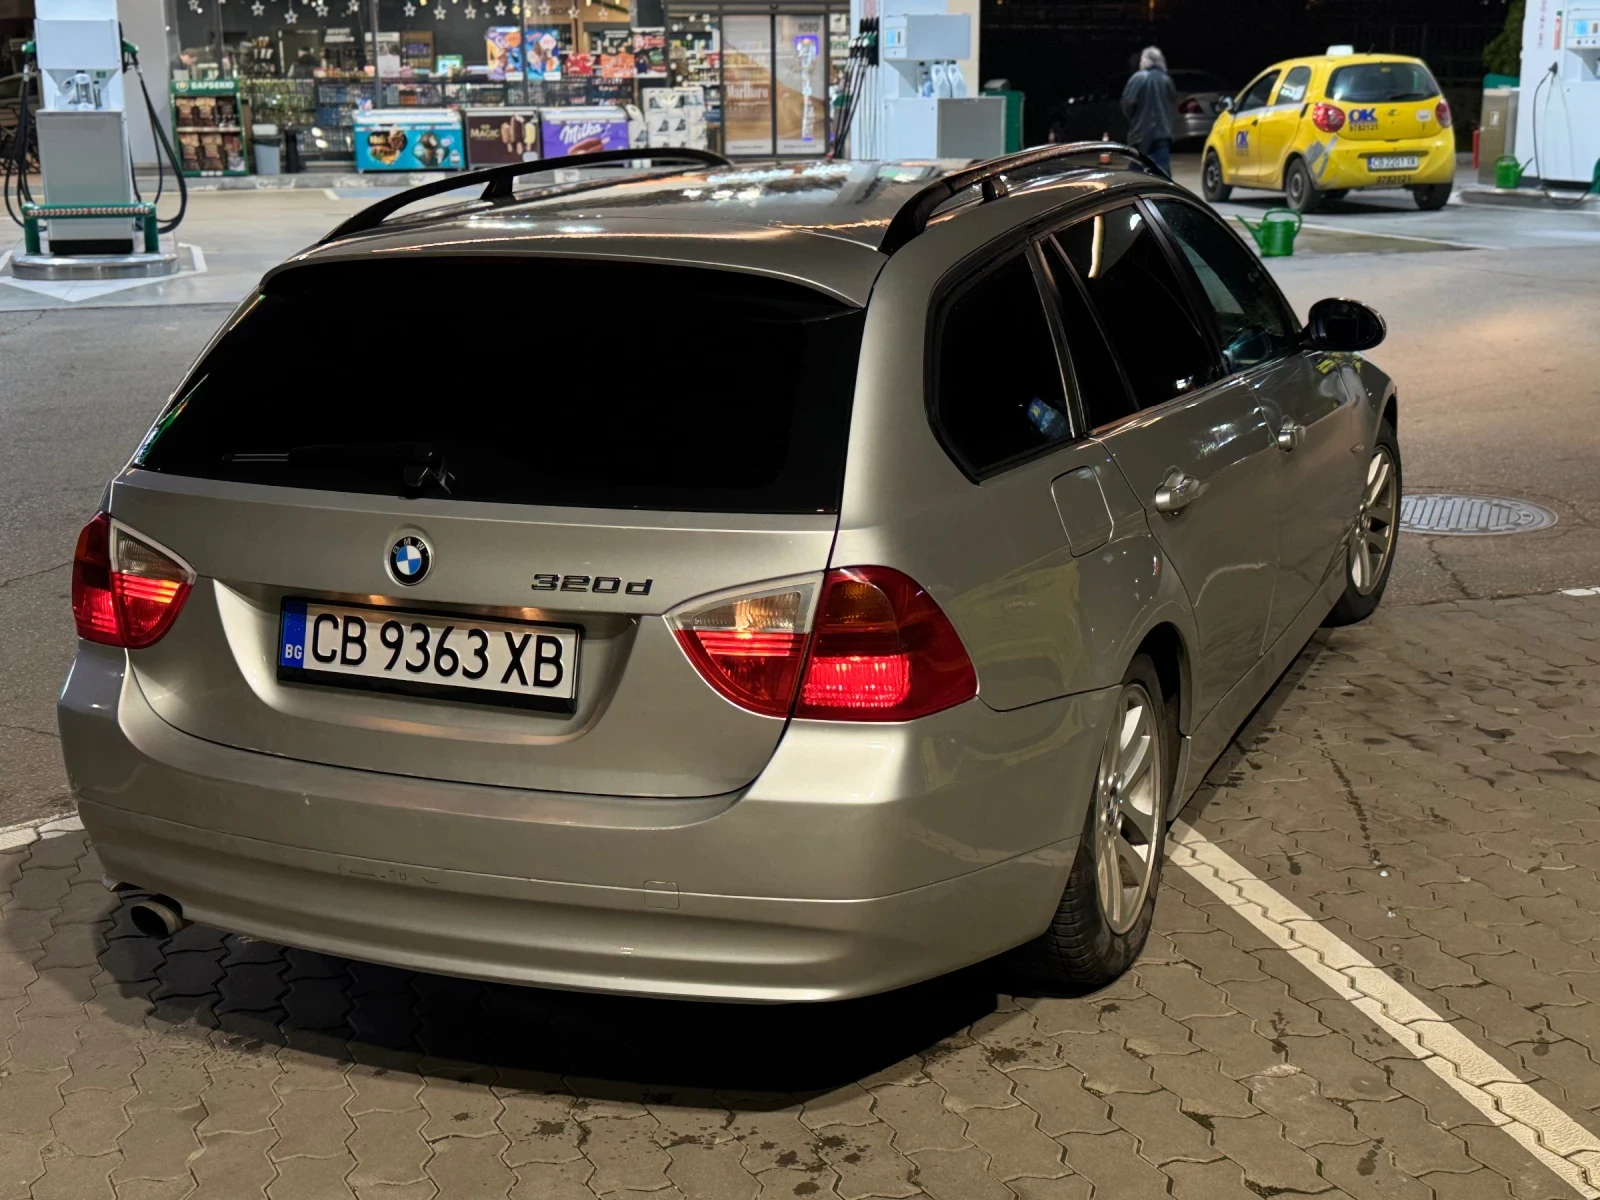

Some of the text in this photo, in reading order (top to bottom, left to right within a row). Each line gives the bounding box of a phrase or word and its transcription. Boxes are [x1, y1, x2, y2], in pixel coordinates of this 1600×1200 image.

[470, 128, 500, 138] MAGIC
[559, 122, 603, 145] Milka
[392, 537, 426, 555] BMW
[530, 573, 654, 596] 320d
[284, 643, 303, 661] BG
[311, 613, 565, 689] CB 9363 XB
